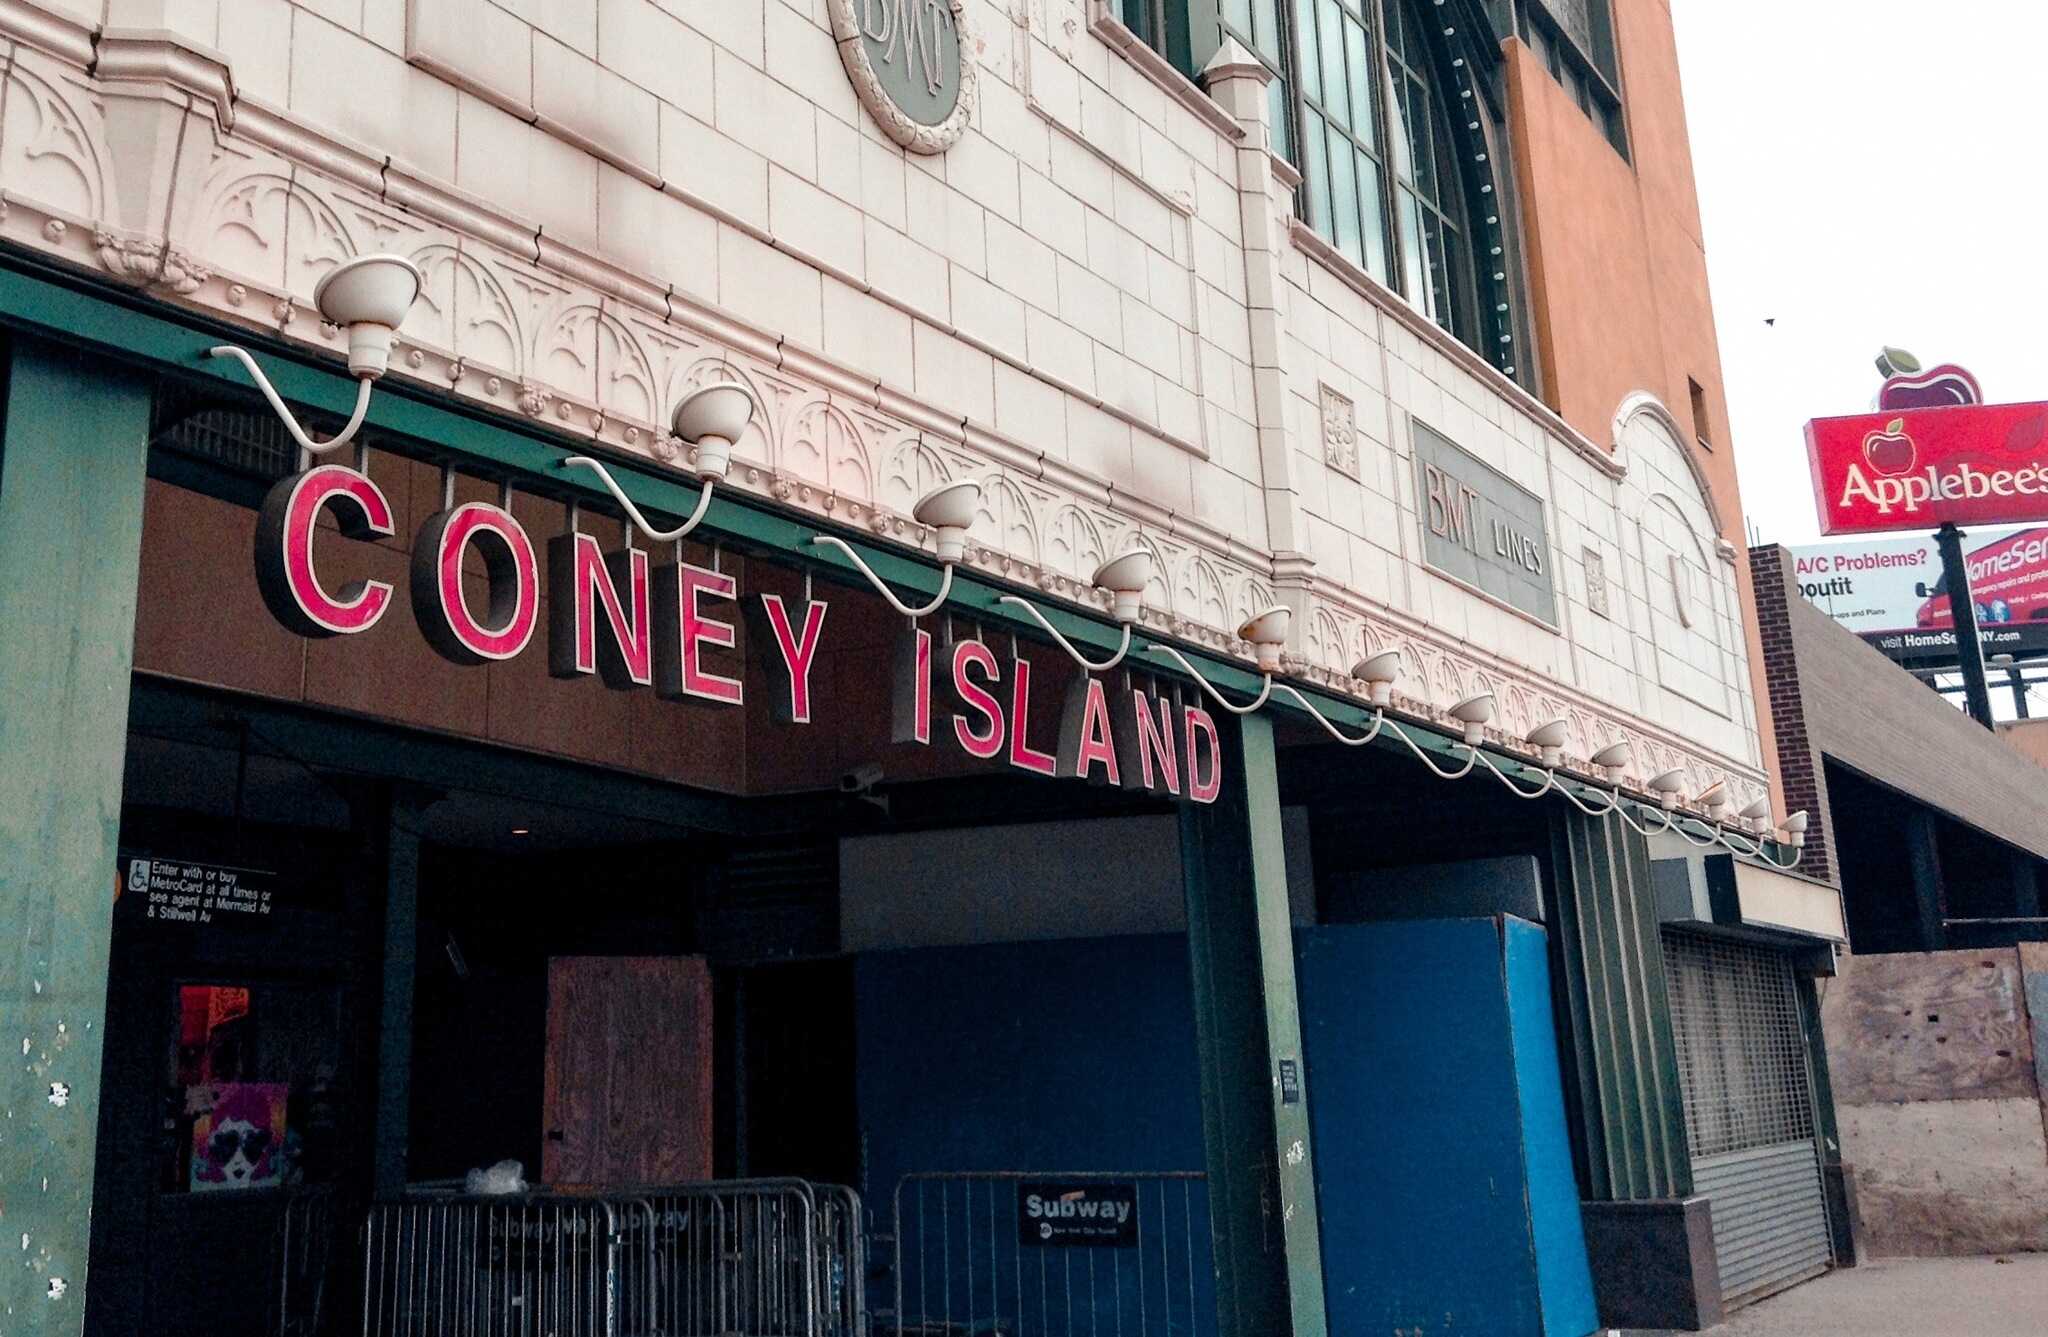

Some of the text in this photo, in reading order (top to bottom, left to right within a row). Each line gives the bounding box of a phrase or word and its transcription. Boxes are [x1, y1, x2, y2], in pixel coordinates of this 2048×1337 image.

[1839, 462, 2048, 514] Applebee's
[1425, 462, 1543, 576] BMT LINES
[1796, 548, 1927, 574] A/C Problems?
[283, 464, 1222, 804] CONEY ISLAND
[1881, 636, 1902, 649] visit
[152, 862, 237, 885] Enter with or buy
[150, 876, 272, 901] MetroCard at all times or
[147, 905, 212, 923] & Stillwell Av
[149, 892, 271, 914] see agent at Mermaid Av
[1026, 1191, 1131, 1223] Subway
